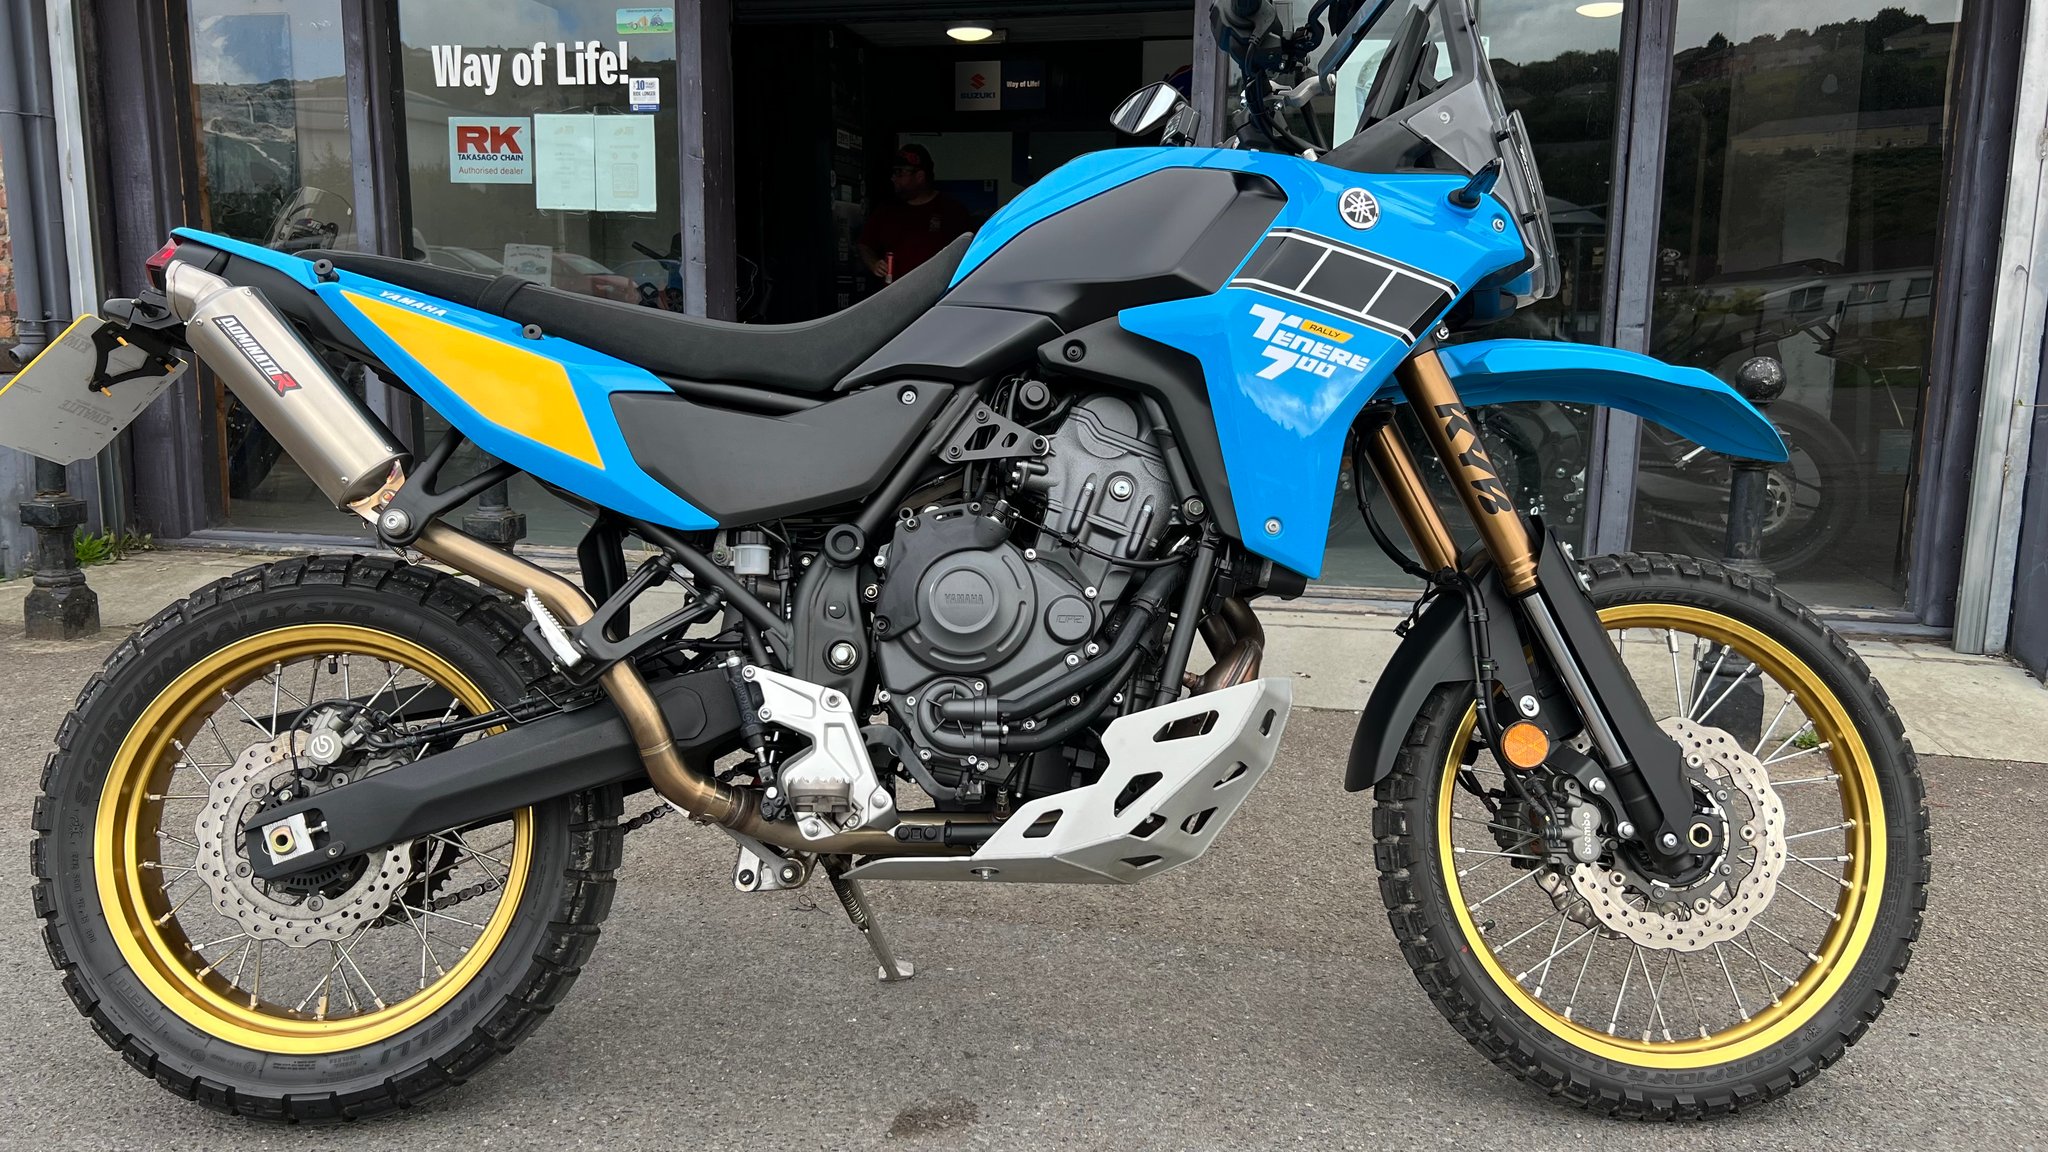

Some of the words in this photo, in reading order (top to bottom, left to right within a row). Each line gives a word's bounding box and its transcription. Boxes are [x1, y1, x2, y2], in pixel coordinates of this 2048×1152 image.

[431, 44, 501, 96] Way
[512, 41, 547, 87] of
[556, 40, 629, 85] Life!
[1006, 80, 1019, 89] Way
[1019, 80, 1026, 88] of
[456, 126, 523, 154] RK
[458, 166, 498, 175] Authorised
[500, 167, 524, 175] dealer
[379, 291, 448, 317] YAMAHA
[1309, 323, 1341, 339] RALLY
[220, 316, 297, 393] DOMINATOR
[1255, 344, 1338, 380] 700
[1434, 403, 1511, 514] KYB
[944, 593, 984, 605] YAMAHA
[1582, 811, 1592, 855] brembo
[380, 975, 494, 1065] PIRELLI
